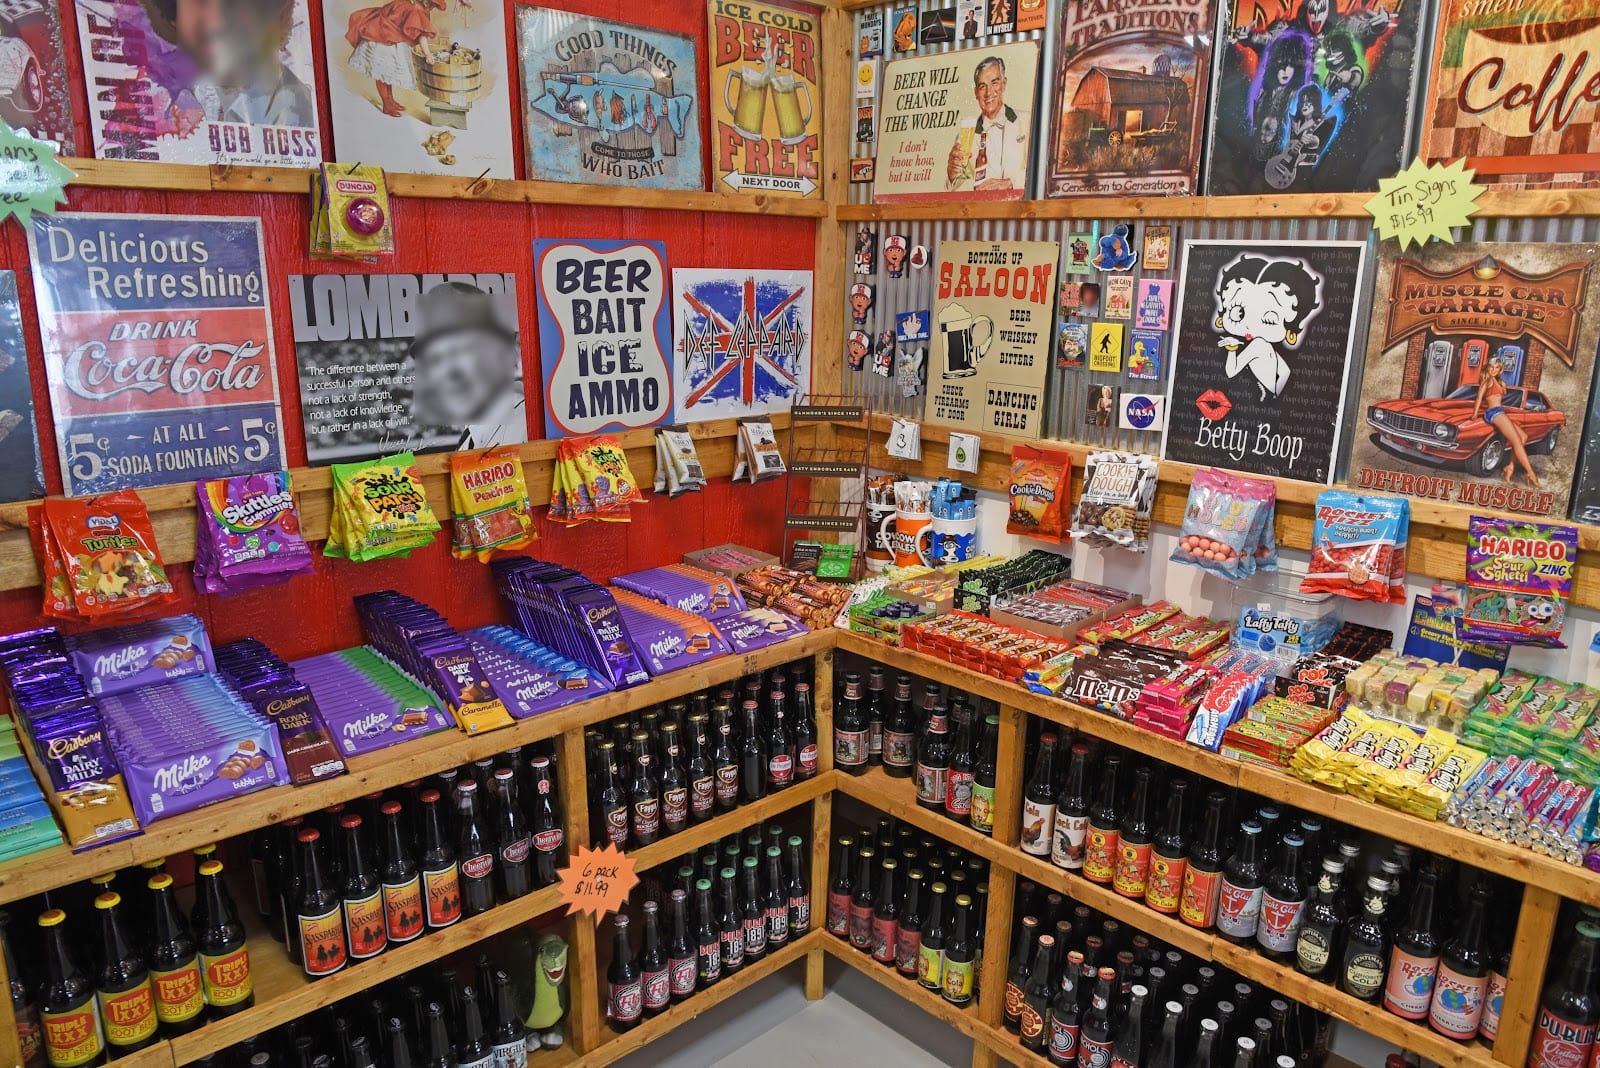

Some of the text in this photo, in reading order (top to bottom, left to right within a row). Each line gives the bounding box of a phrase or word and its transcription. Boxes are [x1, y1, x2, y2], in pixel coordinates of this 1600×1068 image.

[716, 0, 812, 33] ICE COLD
[1072, 9, 1199, 44] TRADITIONS
[555, 30, 678, 79] GOOD THINGS
[715, 15, 817, 85] BEER
[893, 66, 960, 91] BEER WILL
[896, 89, 948, 111] CHANGE
[885, 109, 960, 133] THE WORLD!
[208, 124, 317, 158] BOB ROSS
[717, 120, 818, 180] FREE
[899, 139, 928, 154] I don't
[595, 146, 650, 160] COME TO THOSE
[890, 155, 935, 168] know how,
[582, 152, 665, 180] WHO BAIT
[742, 177, 800, 190] NEXT DOOR
[888, 169, 931, 183] but it will
[1061, 178, 1176, 193] Generation to Generation
[338, 182, 375, 192] DUNCAN
[1385, 179, 1457, 207] Tin Signs
[49, 226, 209, 264] Delicious
[967, 251, 1023, 264] BOTTOMS UP
[87, 266, 261, 303] Refreshing
[556, 259, 651, 295] BEER
[938, 261, 1052, 304] SALOON
[1405, 283, 1568, 306] MUSCLE CAR
[571, 297, 646, 335] BAIT
[1010, 309, 1031, 322] BEER
[1418, 299, 1547, 322] GARAGE
[109, 319, 200, 343] DRINK
[1000, 329, 1038, 344] WHISKEY
[683, 307, 805, 383] DEF LEPPARD
[577, 338, 644, 377] ICE
[1000, 351, 1034, 367] BITTERS
[63, 339, 266, 401] Coca-Cola
[326, 364, 365, 375] difference
[366, 362, 400, 373] between
[306, 379, 346, 391] successful
[347, 377, 375, 389] person
[376, 375, 391, 386] and
[942, 384, 964, 396] CHECK
[308, 395, 322, 405] not
[331, 393, 347, 404] lack
[348, 392, 357, 402] of
[358, 389, 393, 401] strength,
[568, 377, 659, 420] AMMO
[934, 395, 970, 409] FIREARMS
[987, 389, 1037, 411] DANCING
[310, 410, 325, 420] not
[333, 407, 349, 418] lack
[350, 406, 359, 417] of
[360, 403, 405, 415] knowledge,
[936, 407, 965, 421] AT DOOR
[994, 410, 1027, 430] GIRLS
[1128, 408, 1154, 417] NASA
[152, 422, 207, 444] AT ALL
[311, 424, 326, 434] but
[327, 421, 351, 433] rather
[352, 421, 361, 430] in
[369, 418, 384, 429] lack
[385, 417, 394, 427] of
[241, 418, 276, 462] 5¢
[1194, 416, 1303, 469] Betty Boop
[69, 433, 111, 481] 5¢
[108, 445, 240, 477] SODA FOUNTAINS
[461, 462, 515, 490] HARIBO
[1096, 462, 1135, 478] COOKIE
[363, 481, 414, 499] SOUR
[1091, 474, 1135, 493] DOUGH
[1359, 467, 1554, 514] DETROIT MUSCLE
[472, 483, 514, 504] Peaches
[222, 491, 293, 526] Skittles
[368, 493, 423, 514] PATCH
[91, 518, 116, 527] VIDAL
[242, 501, 294, 527] Gummies
[1323, 515, 1376, 528] FIZZ
[82, 535, 139, 552] Turtles
[1479, 535, 1566, 561] HARIBO
[1493, 556, 1525, 571] Sour
[1477, 566, 1529, 582] Sghetti
[678, 593, 706, 612] Milka
[587, 603, 618, 623] Cadbury
[598, 625, 619, 636] DAIRY
[731, 622, 760, 641] Milka
[1244, 615, 1300, 635] Laffy Taffy
[602, 631, 624, 642] MILK
[650, 635, 682, 657] Milka
[93, 645, 147, 675] Milka
[434, 654, 476, 670] Cadbury
[165, 667, 186, 678] bubbly
[1298, 667, 1328, 682] POP
[515, 678, 553, 701] Milka
[1288, 684, 1309, 694] POP
[266, 694, 310, 716] Cadbury
[461, 701, 503, 717] Caramello
[279, 712, 309, 725] ROYAL
[282, 717, 313, 730] DARK
[343, 712, 389, 738] Milka
[48, 731, 102, 760] Cadbury
[61, 758, 100, 776] DAIRY
[66, 766, 103, 783] MILK
[153, 753, 212, 791] Milka
[232, 778, 256, 790] bubbly
[1025, 804, 1040, 817] Cola
[582, 862, 619, 882] 6 pack
[574, 880, 609, 897] $11.99
[158, 973, 197, 989] TRIPLE
[1352, 975, 1379, 986] COLA
[166, 982, 197, 999] XXX
[111, 991, 150, 1012] TRIPLE
[121, 1004, 153, 1022] XXX
